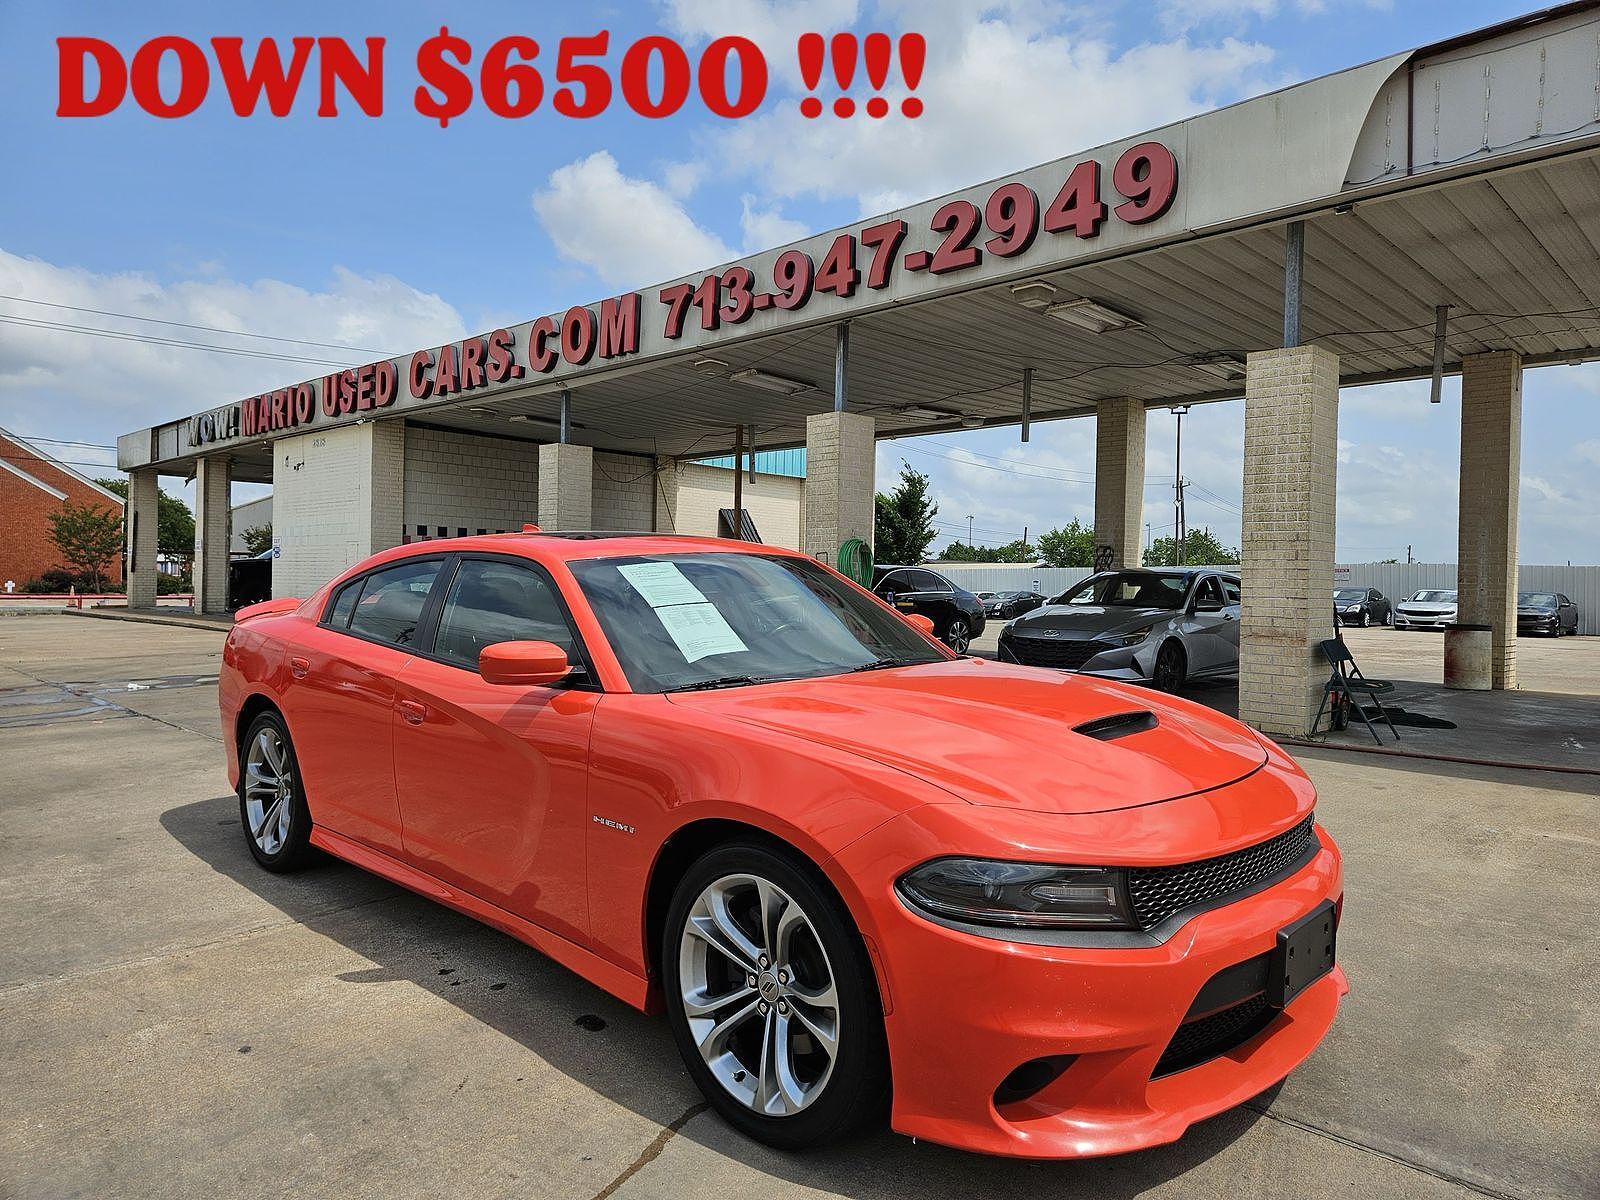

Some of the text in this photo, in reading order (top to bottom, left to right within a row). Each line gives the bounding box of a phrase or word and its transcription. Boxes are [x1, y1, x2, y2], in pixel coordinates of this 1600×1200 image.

[186, 141, 1178, 447] WOW! MARIO USED CARS.COM 713-947-2949
[593, 815, 635, 834] HEMI
